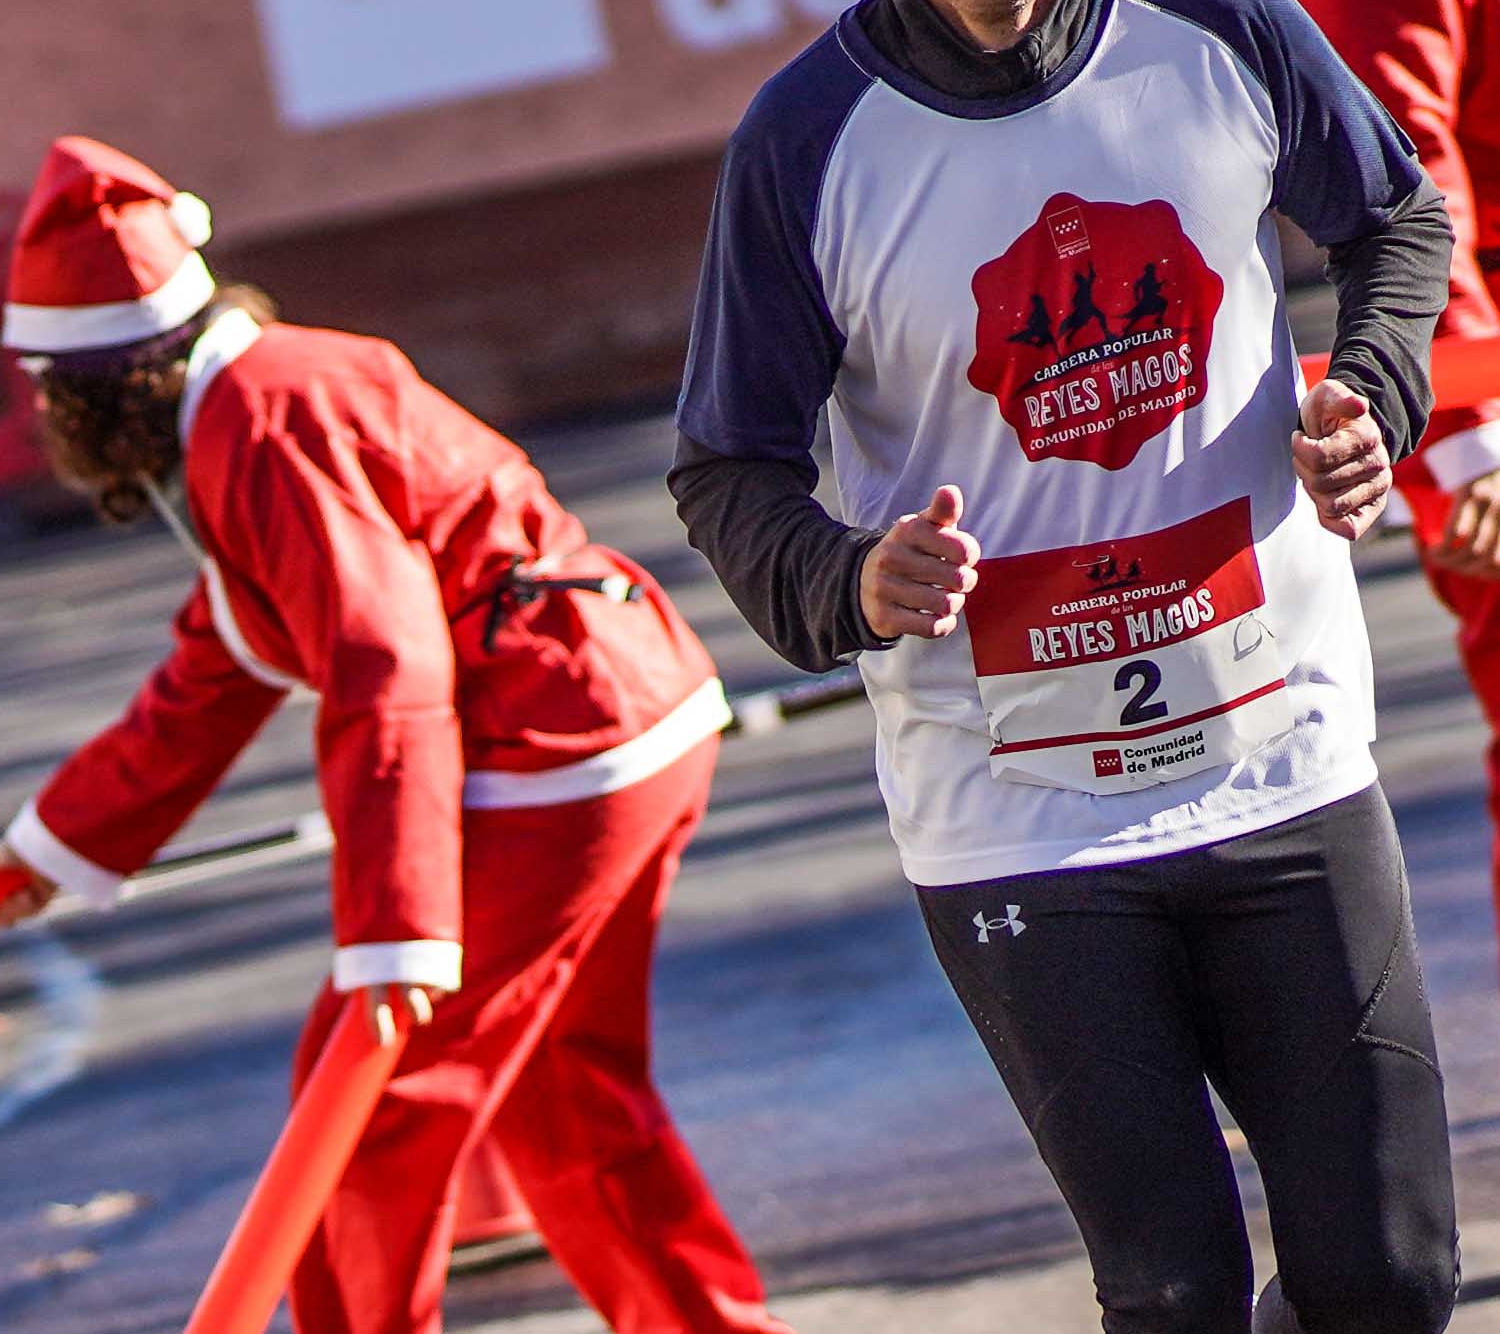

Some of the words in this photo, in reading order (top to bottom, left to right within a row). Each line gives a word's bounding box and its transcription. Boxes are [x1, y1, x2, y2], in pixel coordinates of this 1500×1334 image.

[1034, 349, 1100, 382] CARRERA
[1103, 327, 1173, 357] POPULAR
[1024, 377, 1100, 428] REYES
[1108, 343, 1193, 405] MAGOS
[1118, 405, 1137, 421] DE
[1140, 385, 1197, 414] MADRID
[1051, 594, 1119, 616] CARRERA
[1122, 579, 1187, 602] POPULAR
[1028, 620, 1116, 663] REYES
[1125, 588, 1216, 649] MAGOS
[1114, 659, 1168, 726] 2
[1124, 730, 1204, 759] Comunidad
[1127, 761, 1147, 774] de
[1151, 744, 1206, 769] Madrid
